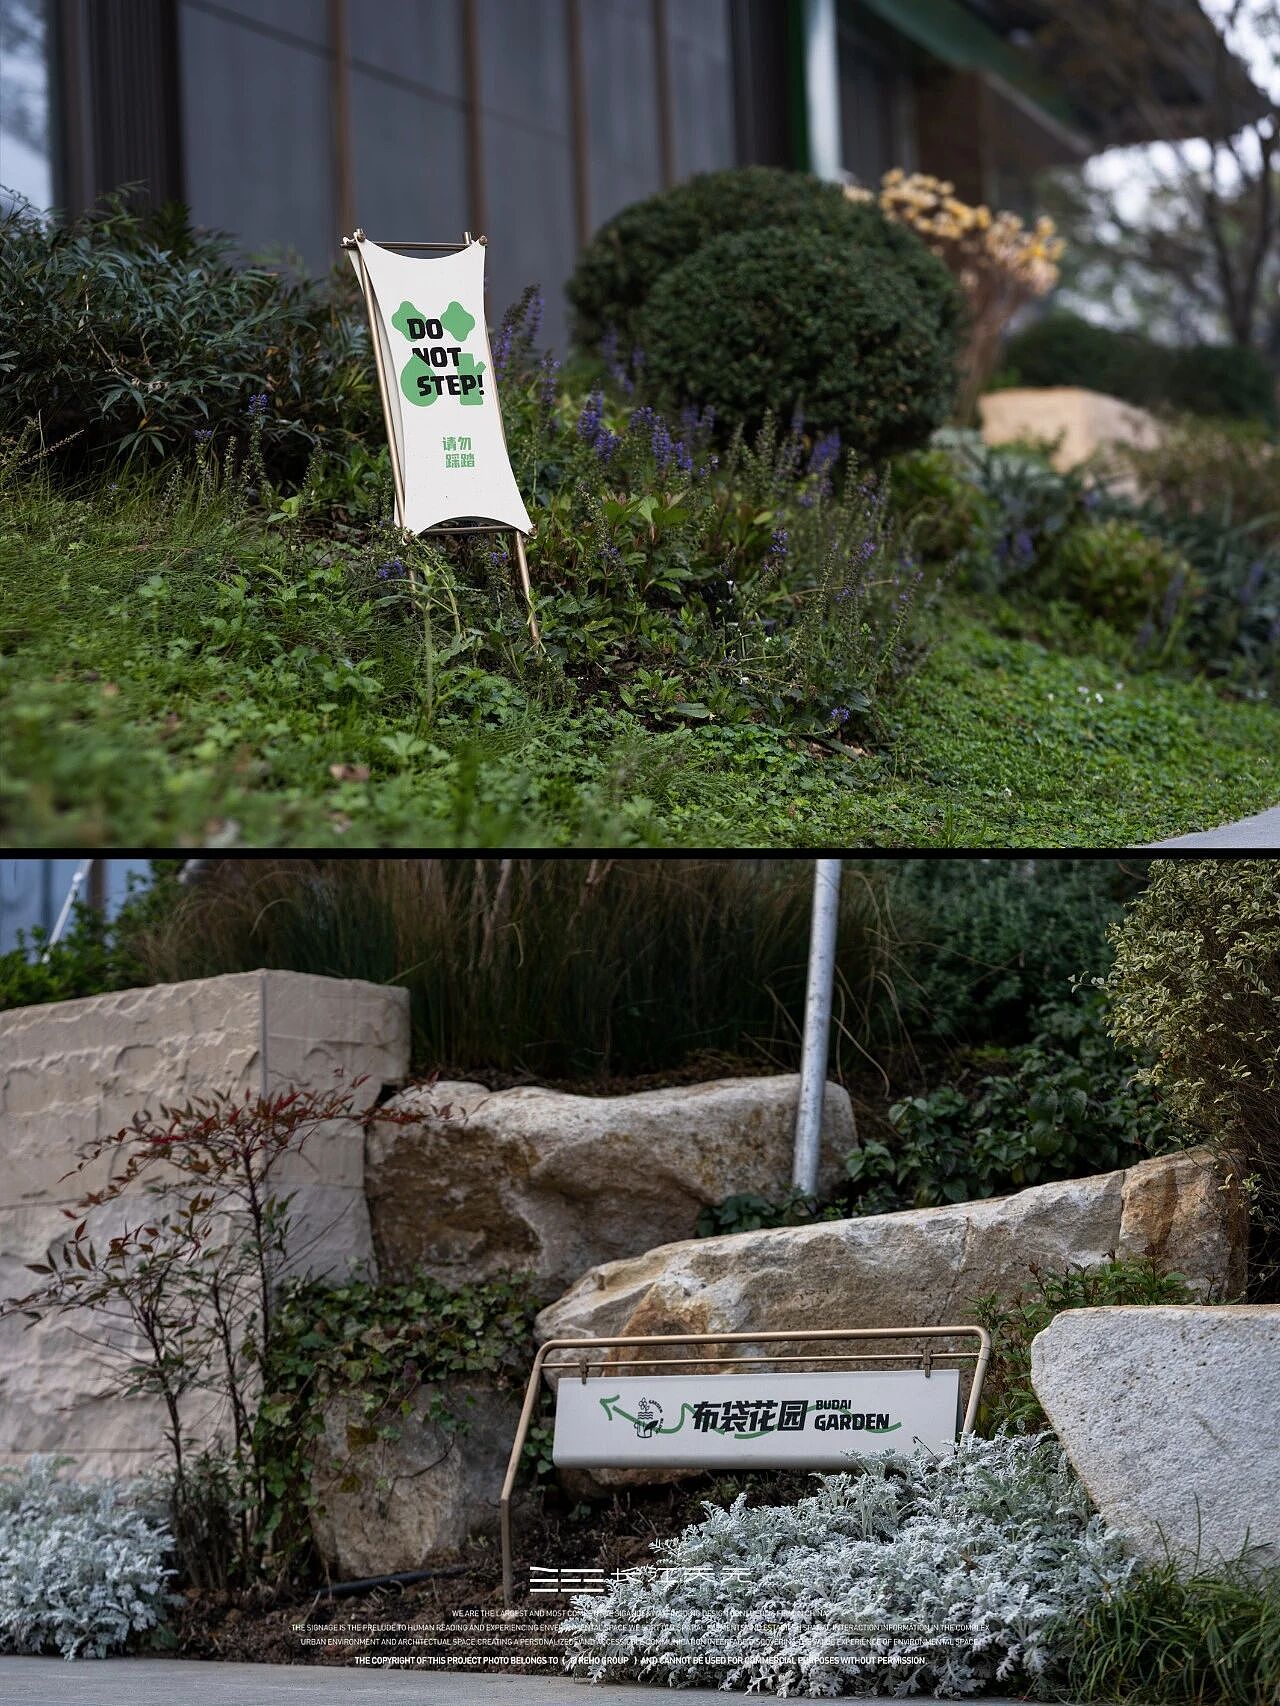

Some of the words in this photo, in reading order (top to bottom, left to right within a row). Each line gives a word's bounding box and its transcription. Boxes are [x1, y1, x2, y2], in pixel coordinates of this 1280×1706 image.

[407, 318, 444, 340] DO
[412, 347, 462, 368] NOT
[417, 375, 485, 397] STEP!
[443, 436, 472, 451] 请勿
[446, 453, 475, 468] 踩踏
[816, 1400, 852, 1411] BUDAI
[692, 1400, 809, 1433] 布袋花园
[815, 1413, 890, 1431] GARDEN
